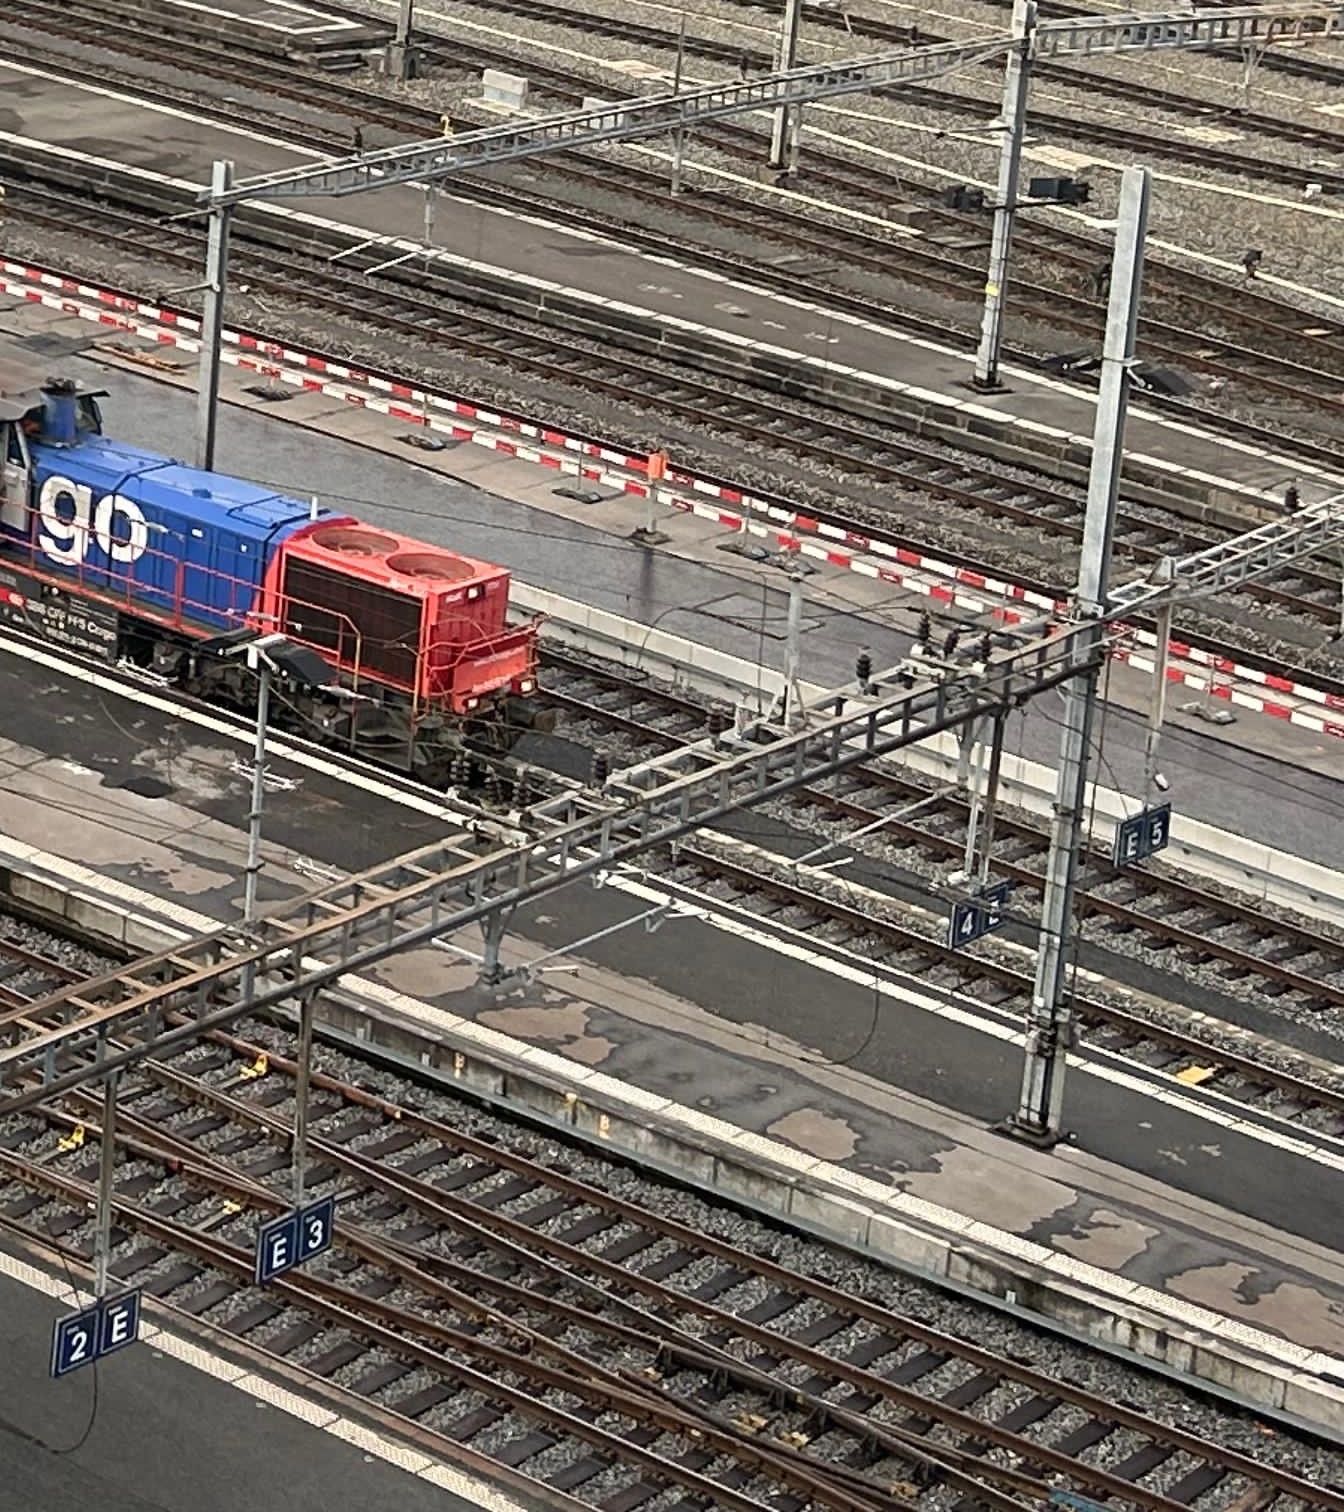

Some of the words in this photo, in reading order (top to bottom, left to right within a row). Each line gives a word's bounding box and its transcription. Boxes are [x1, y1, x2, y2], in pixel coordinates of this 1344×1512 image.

[87, 621, 117, 641] Cargo
[1127, 832, 1139, 857] E
[1151, 821, 1163, 846] 5
[961, 913, 973, 936] 4
[272, 1237, 287, 1269] E
[308, 1219, 323, 1249] 3
[69, 1331, 87, 1362] 2
[112, 1309, 129, 1343] E
